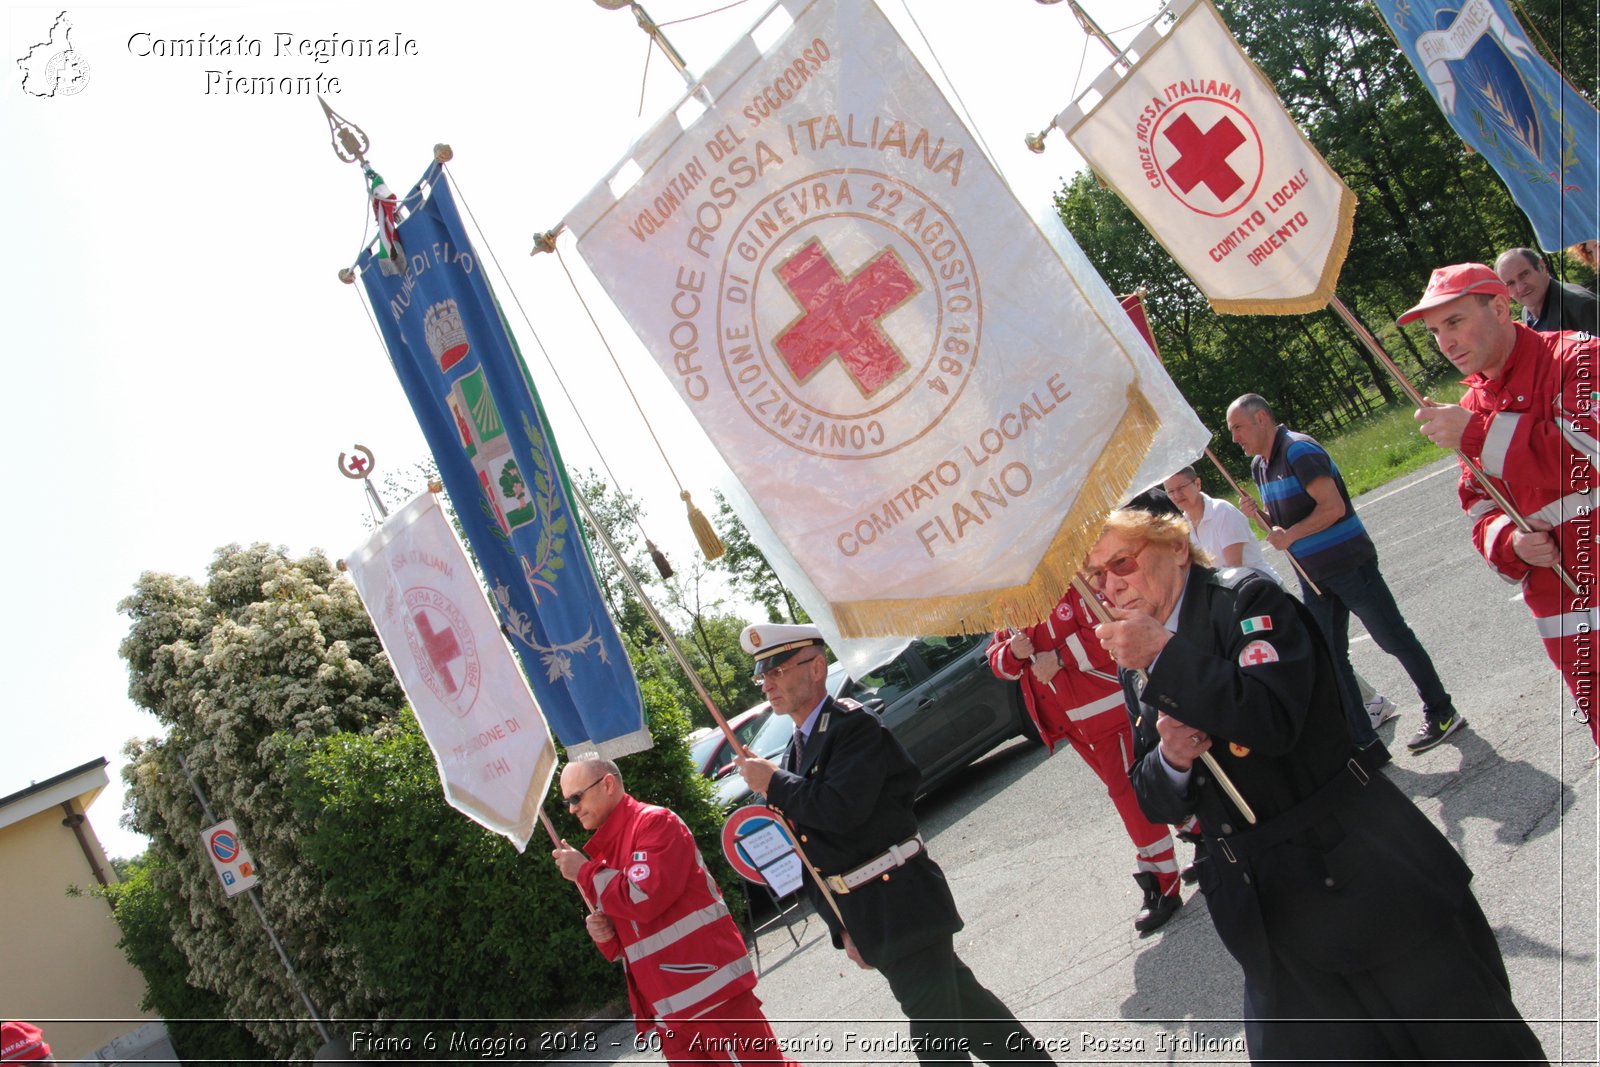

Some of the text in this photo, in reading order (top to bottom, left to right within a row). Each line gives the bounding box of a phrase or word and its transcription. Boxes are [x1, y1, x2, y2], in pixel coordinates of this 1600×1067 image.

[628, 38, 831, 242] VOLONTARI DEL SOCCORSO
[1137, 79, 1241, 189] CROCE ROSSA ITALIANA
[1247, 211, 1309, 267] DRUENTO
[1265, 168, 1309, 213] LOCALE
[411, 250, 431, 276] DI
[669, 113, 965, 401] CROCE ROSSA ITALIANA
[726, 178, 972, 450] CONVENZIONE DI GINEVRA 22 AGOSTO 1864
[836, 372, 1072, 557] COMITATO LOCALE
[915, 461, 1033, 559] FIANO
[505, 717, 521, 733] DI
[1, 1038, 30, 1056] ANFARA
